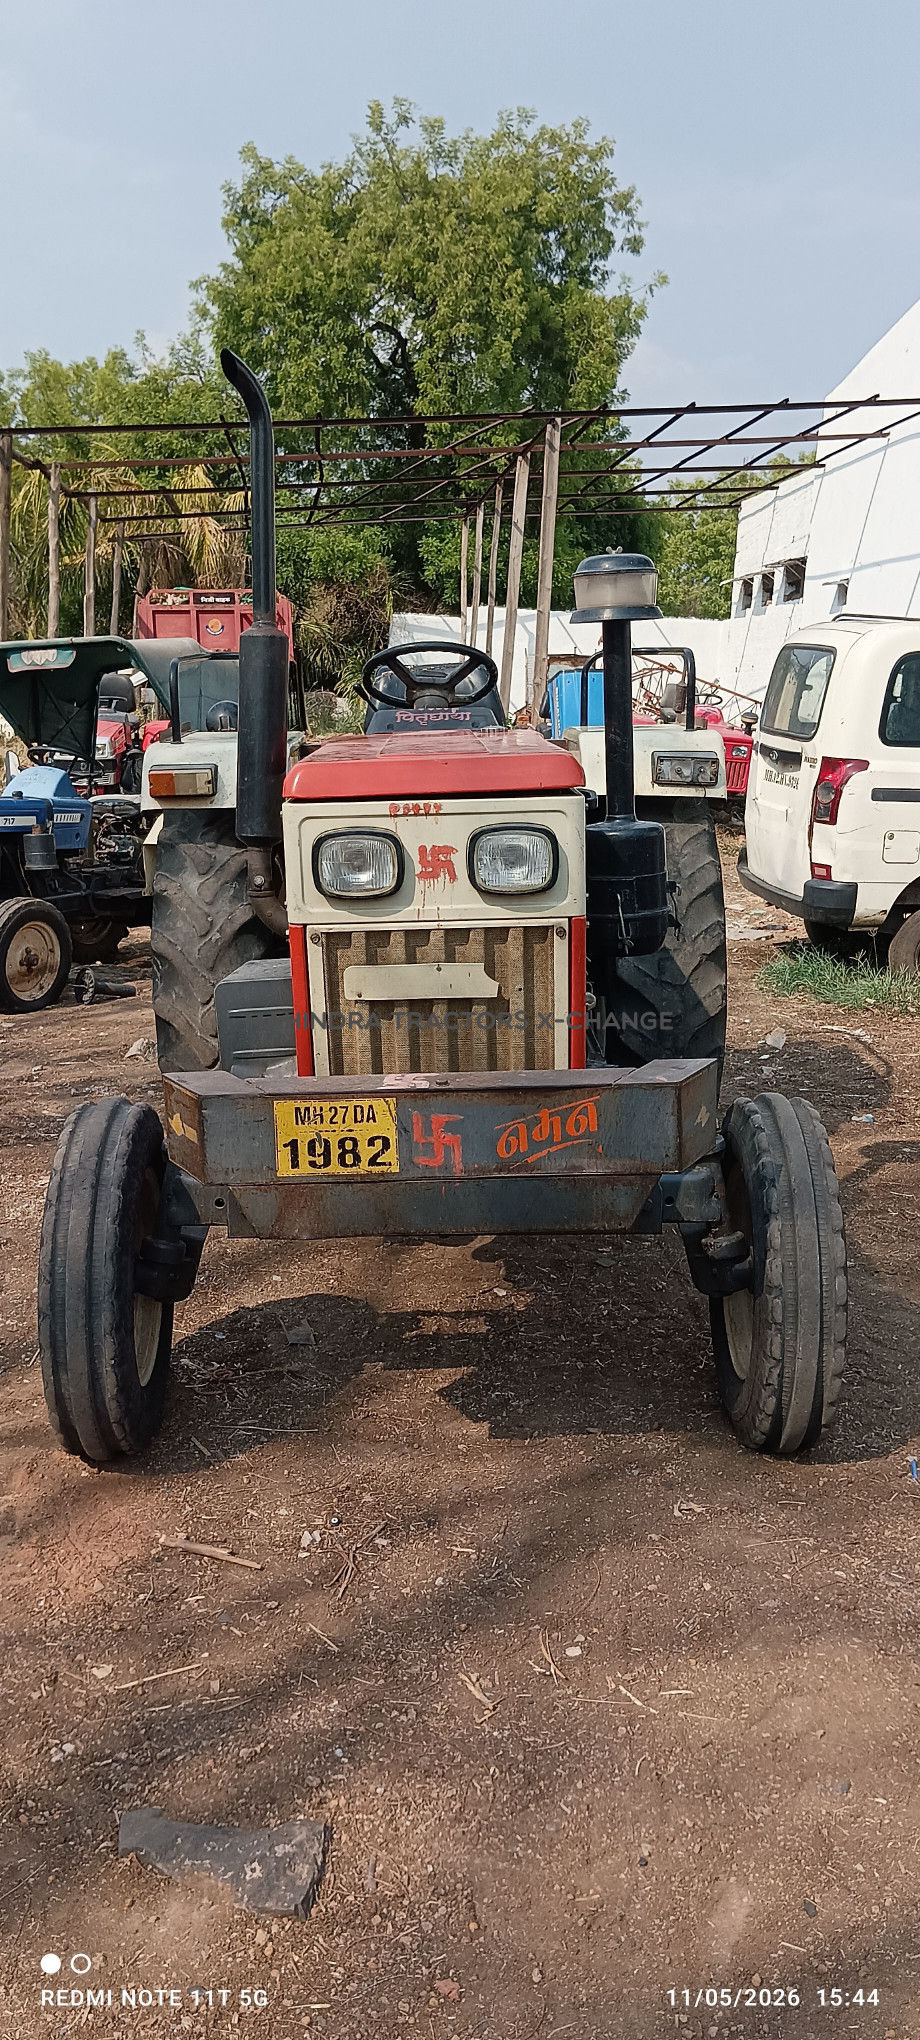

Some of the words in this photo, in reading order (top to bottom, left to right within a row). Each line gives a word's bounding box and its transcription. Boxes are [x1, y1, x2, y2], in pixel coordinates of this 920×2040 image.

[3, 817, 16, 826] 717
[494, 1095, 600, 1159] नमन
[282, 1135, 393, 1170] 1982
